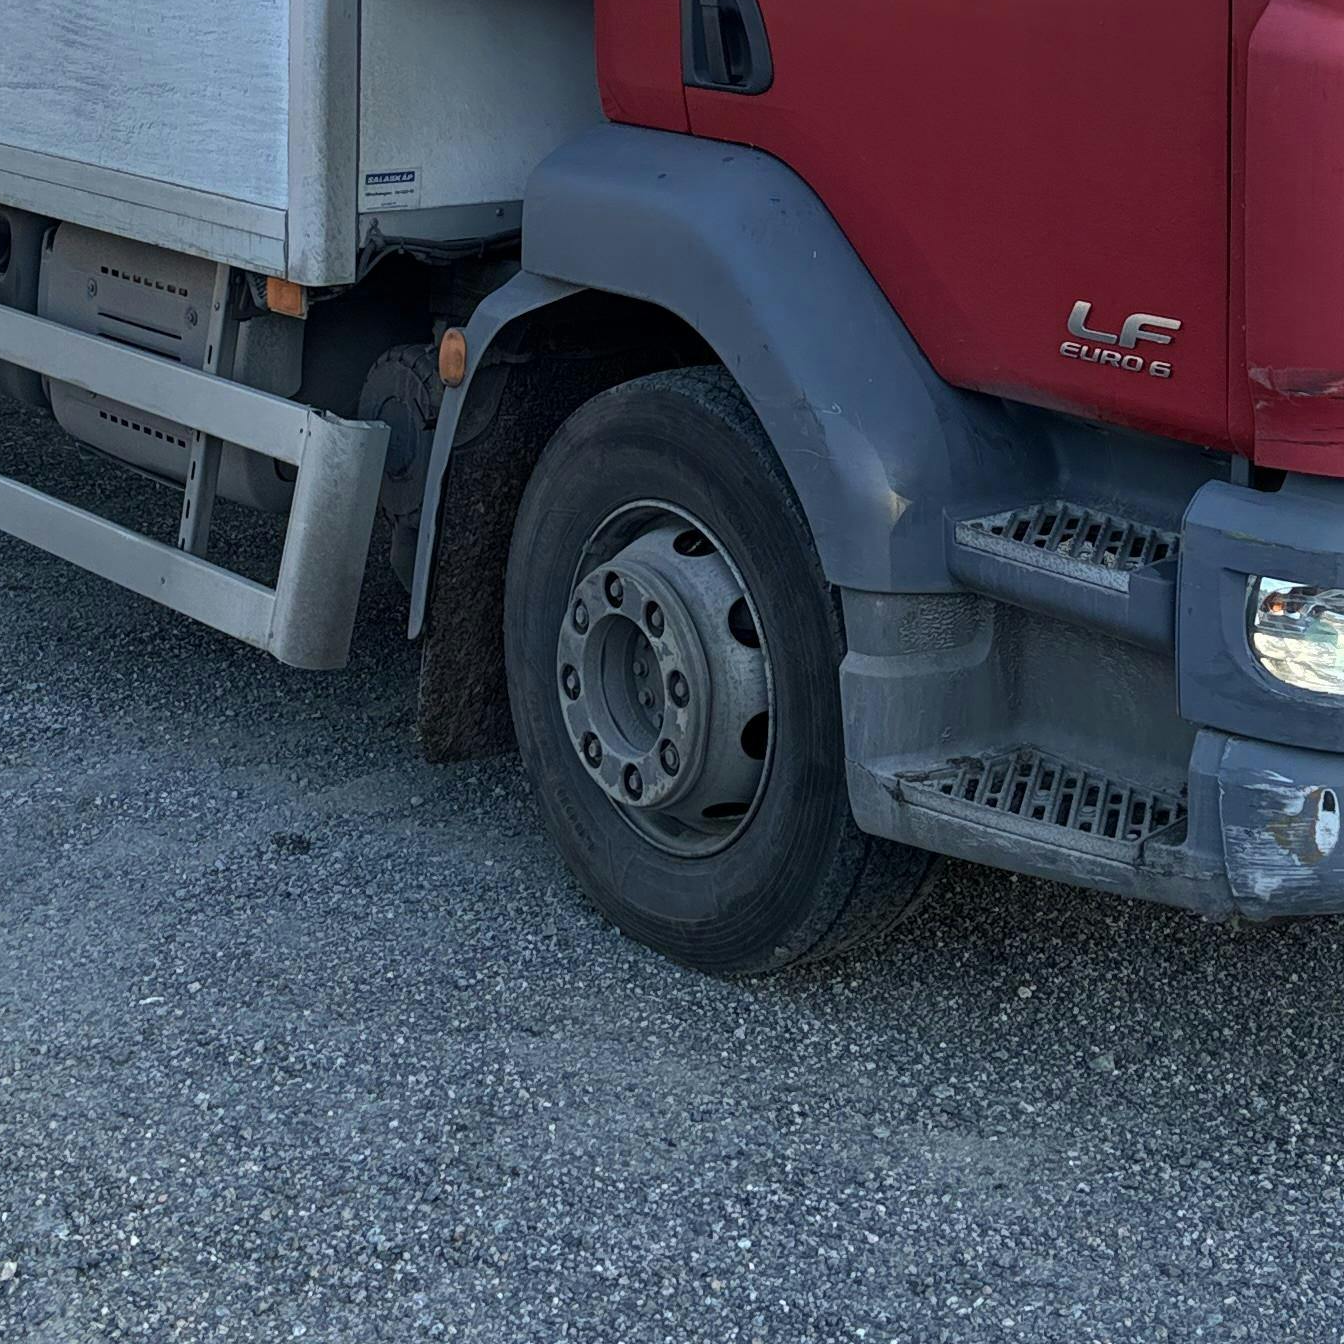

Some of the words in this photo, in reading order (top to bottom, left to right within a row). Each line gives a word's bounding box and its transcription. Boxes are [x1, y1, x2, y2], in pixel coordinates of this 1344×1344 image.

[1067, 300, 1182, 349] LF
[1059, 341, 1144, 372] EURO
[1148, 360, 1172, 378] 6
